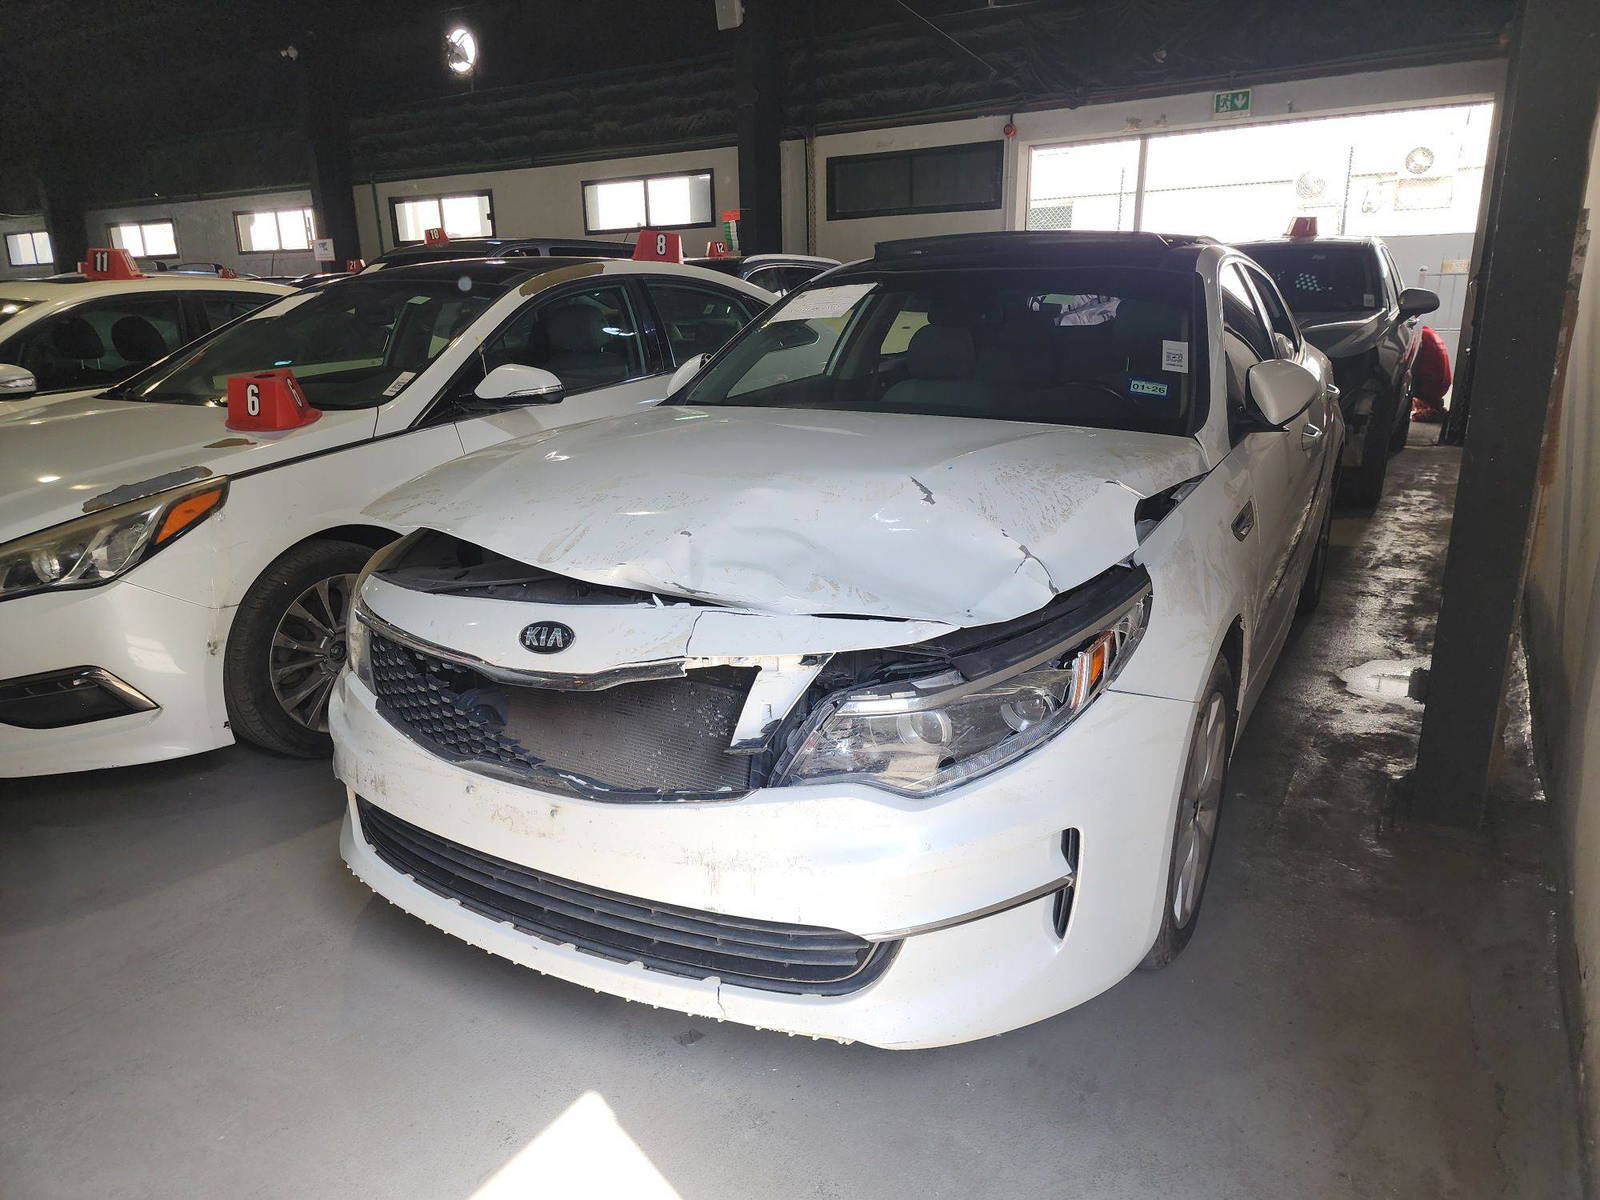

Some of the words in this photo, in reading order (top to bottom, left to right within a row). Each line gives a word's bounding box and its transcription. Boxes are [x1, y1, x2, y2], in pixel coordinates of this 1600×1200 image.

[656, 233, 667, 256] 8
[716, 242, 725, 254] 12
[96, 252, 108, 272] 11
[247, 384, 260, 416] 6
[525, 626, 564, 648] KIA
